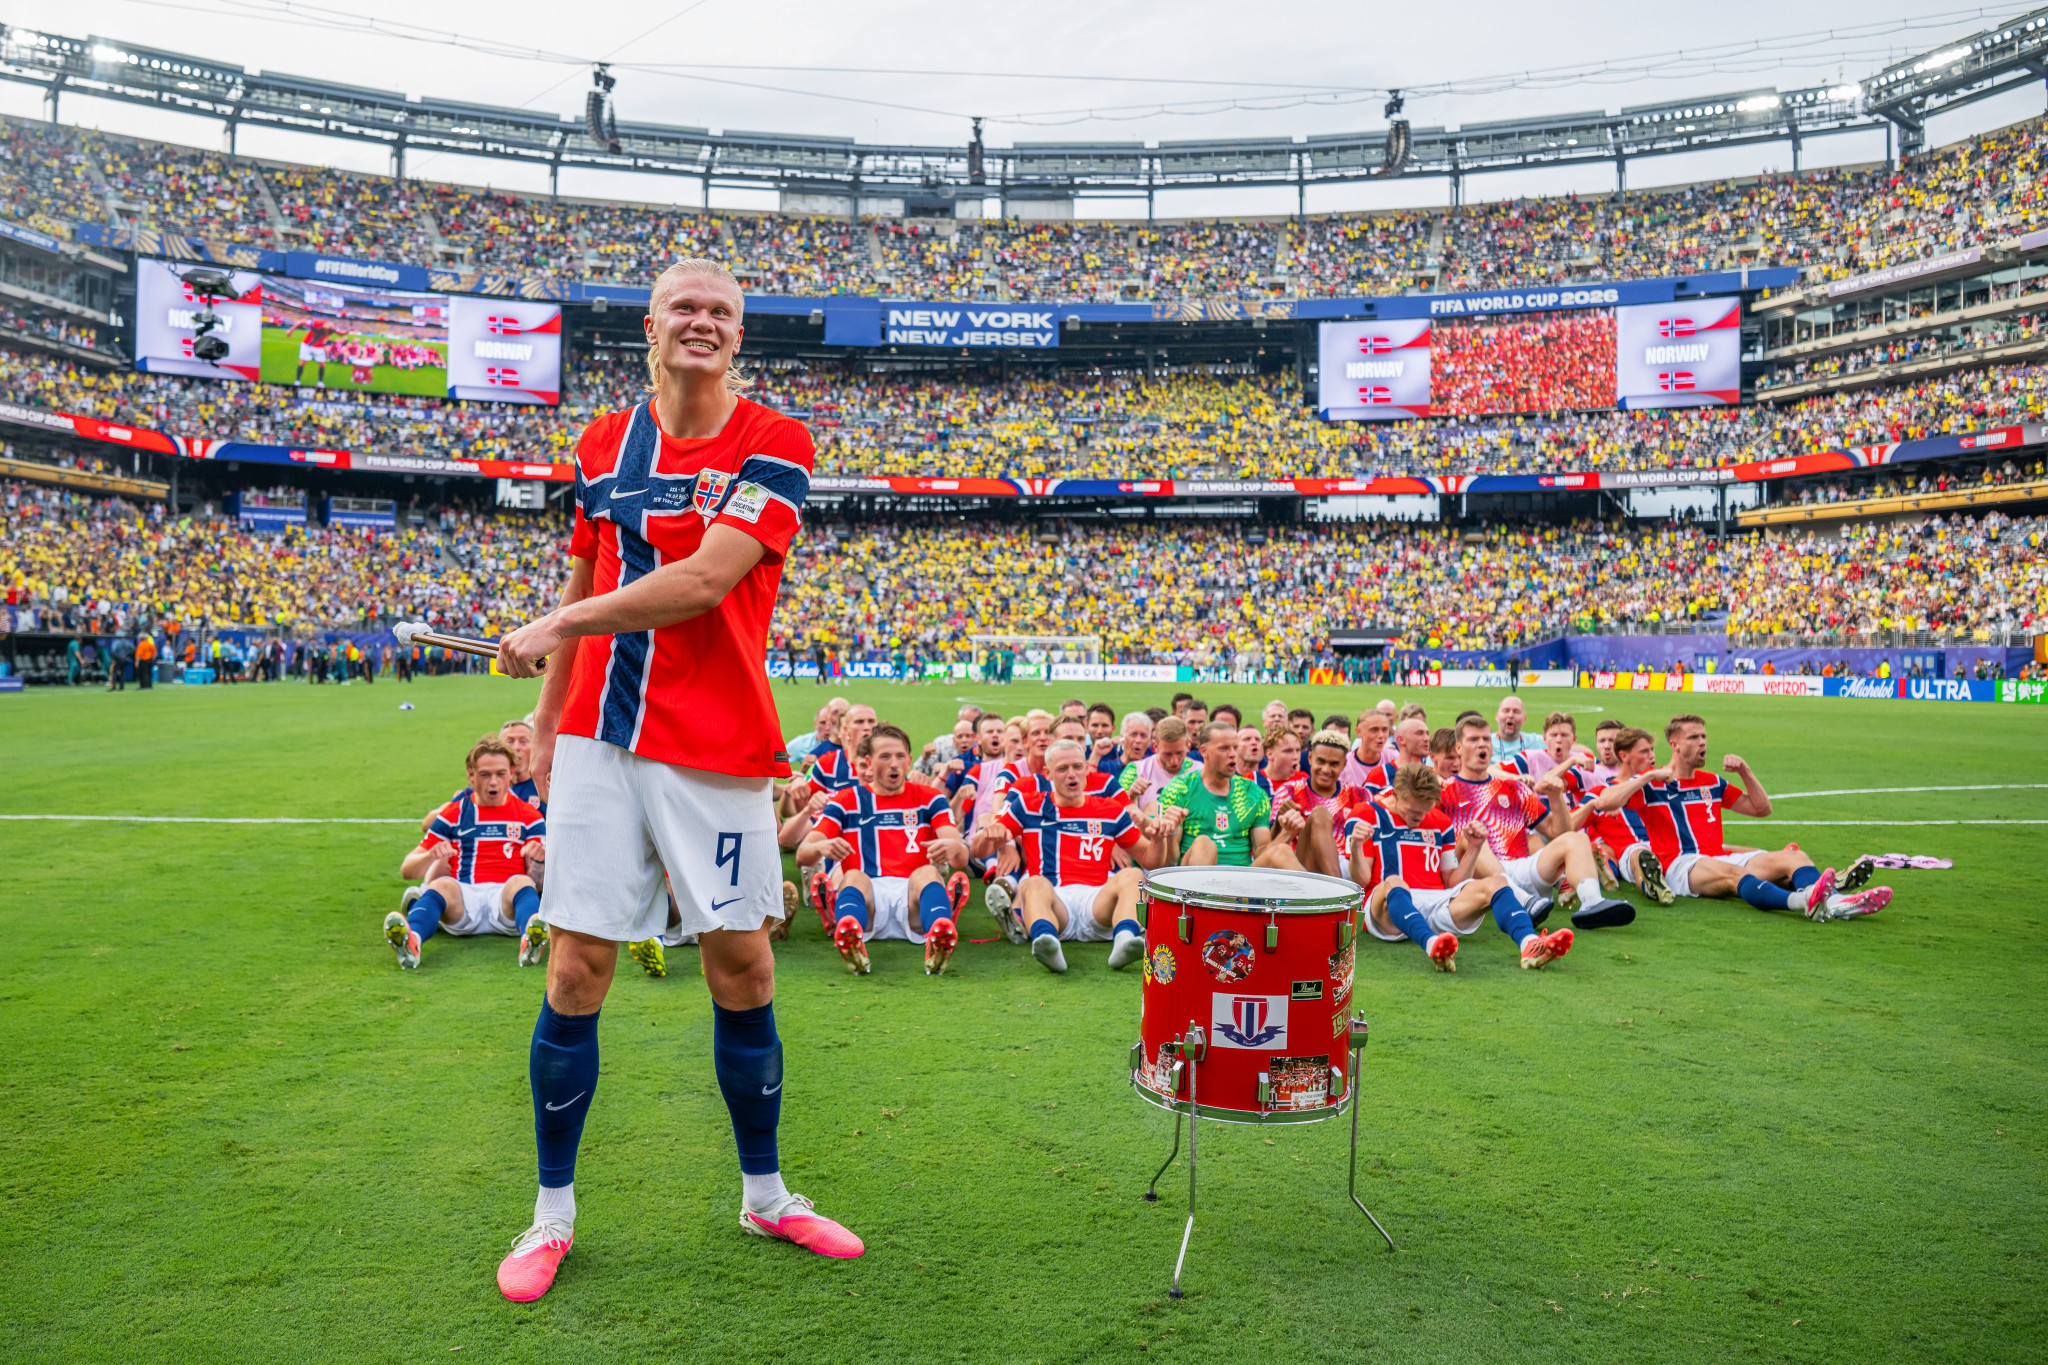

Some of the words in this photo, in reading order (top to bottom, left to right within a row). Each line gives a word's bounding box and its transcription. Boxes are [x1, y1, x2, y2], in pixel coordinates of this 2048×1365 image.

[1834, 279, 1860, 294] NEW
[1863, 271, 1892, 287] YORK
[1894, 264, 1921, 280] NEW
[1924, 251, 1972, 272] JERSEY
[1430, 299, 1464, 314] FIFA
[1466, 295, 1526, 311] WORLD
[1526, 292, 1559, 308] CUP
[1560, 288, 1619, 306] 2026
[889, 310, 961, 328] NEW
[967, 311, 1054, 329] YORK
[889, 330, 947, 345] NEW
[952, 332, 1053, 346] JERSEY
[475, 341, 533, 361] NORWAY
[1645, 343, 1709, 365] NORWAY
[1346, 361, 1404, 379] NORWAY
[1976, 431, 2007, 447] NORWAY
[366, 456, 389, 466] FIFA
[389, 457, 425, 469] WORLD
[425, 460, 445, 471] CUP
[445, 460, 479, 474] 2026
[1188, 482, 1210, 492] FIFA
[1210, 482, 1242, 492] WORLD
[1243, 482, 1262, 492] CUP
[1262, 481, 1295, 492] 2026
[1616, 474, 1638, 485] FIFA
[1639, 472, 1677, 483] WORLD
[1677, 471, 1699, 482] CUP
[731, 500, 756, 514] EDUCATION
[1707, 675, 1744, 693] verizon
[1764, 675, 1807, 695] verizon
[1840, 676, 1894, 699] Michelob
[1911, 679, 1972, 701] ULTRA
[2018, 682, 2045, 702] 蒙牛
[1705, 801, 1716, 823] 3
[904, 829, 919, 853] 8
[1079, 836, 1105, 861] 26
[715, 832, 743, 887] 9
[1423, 846, 1440, 872] 10
